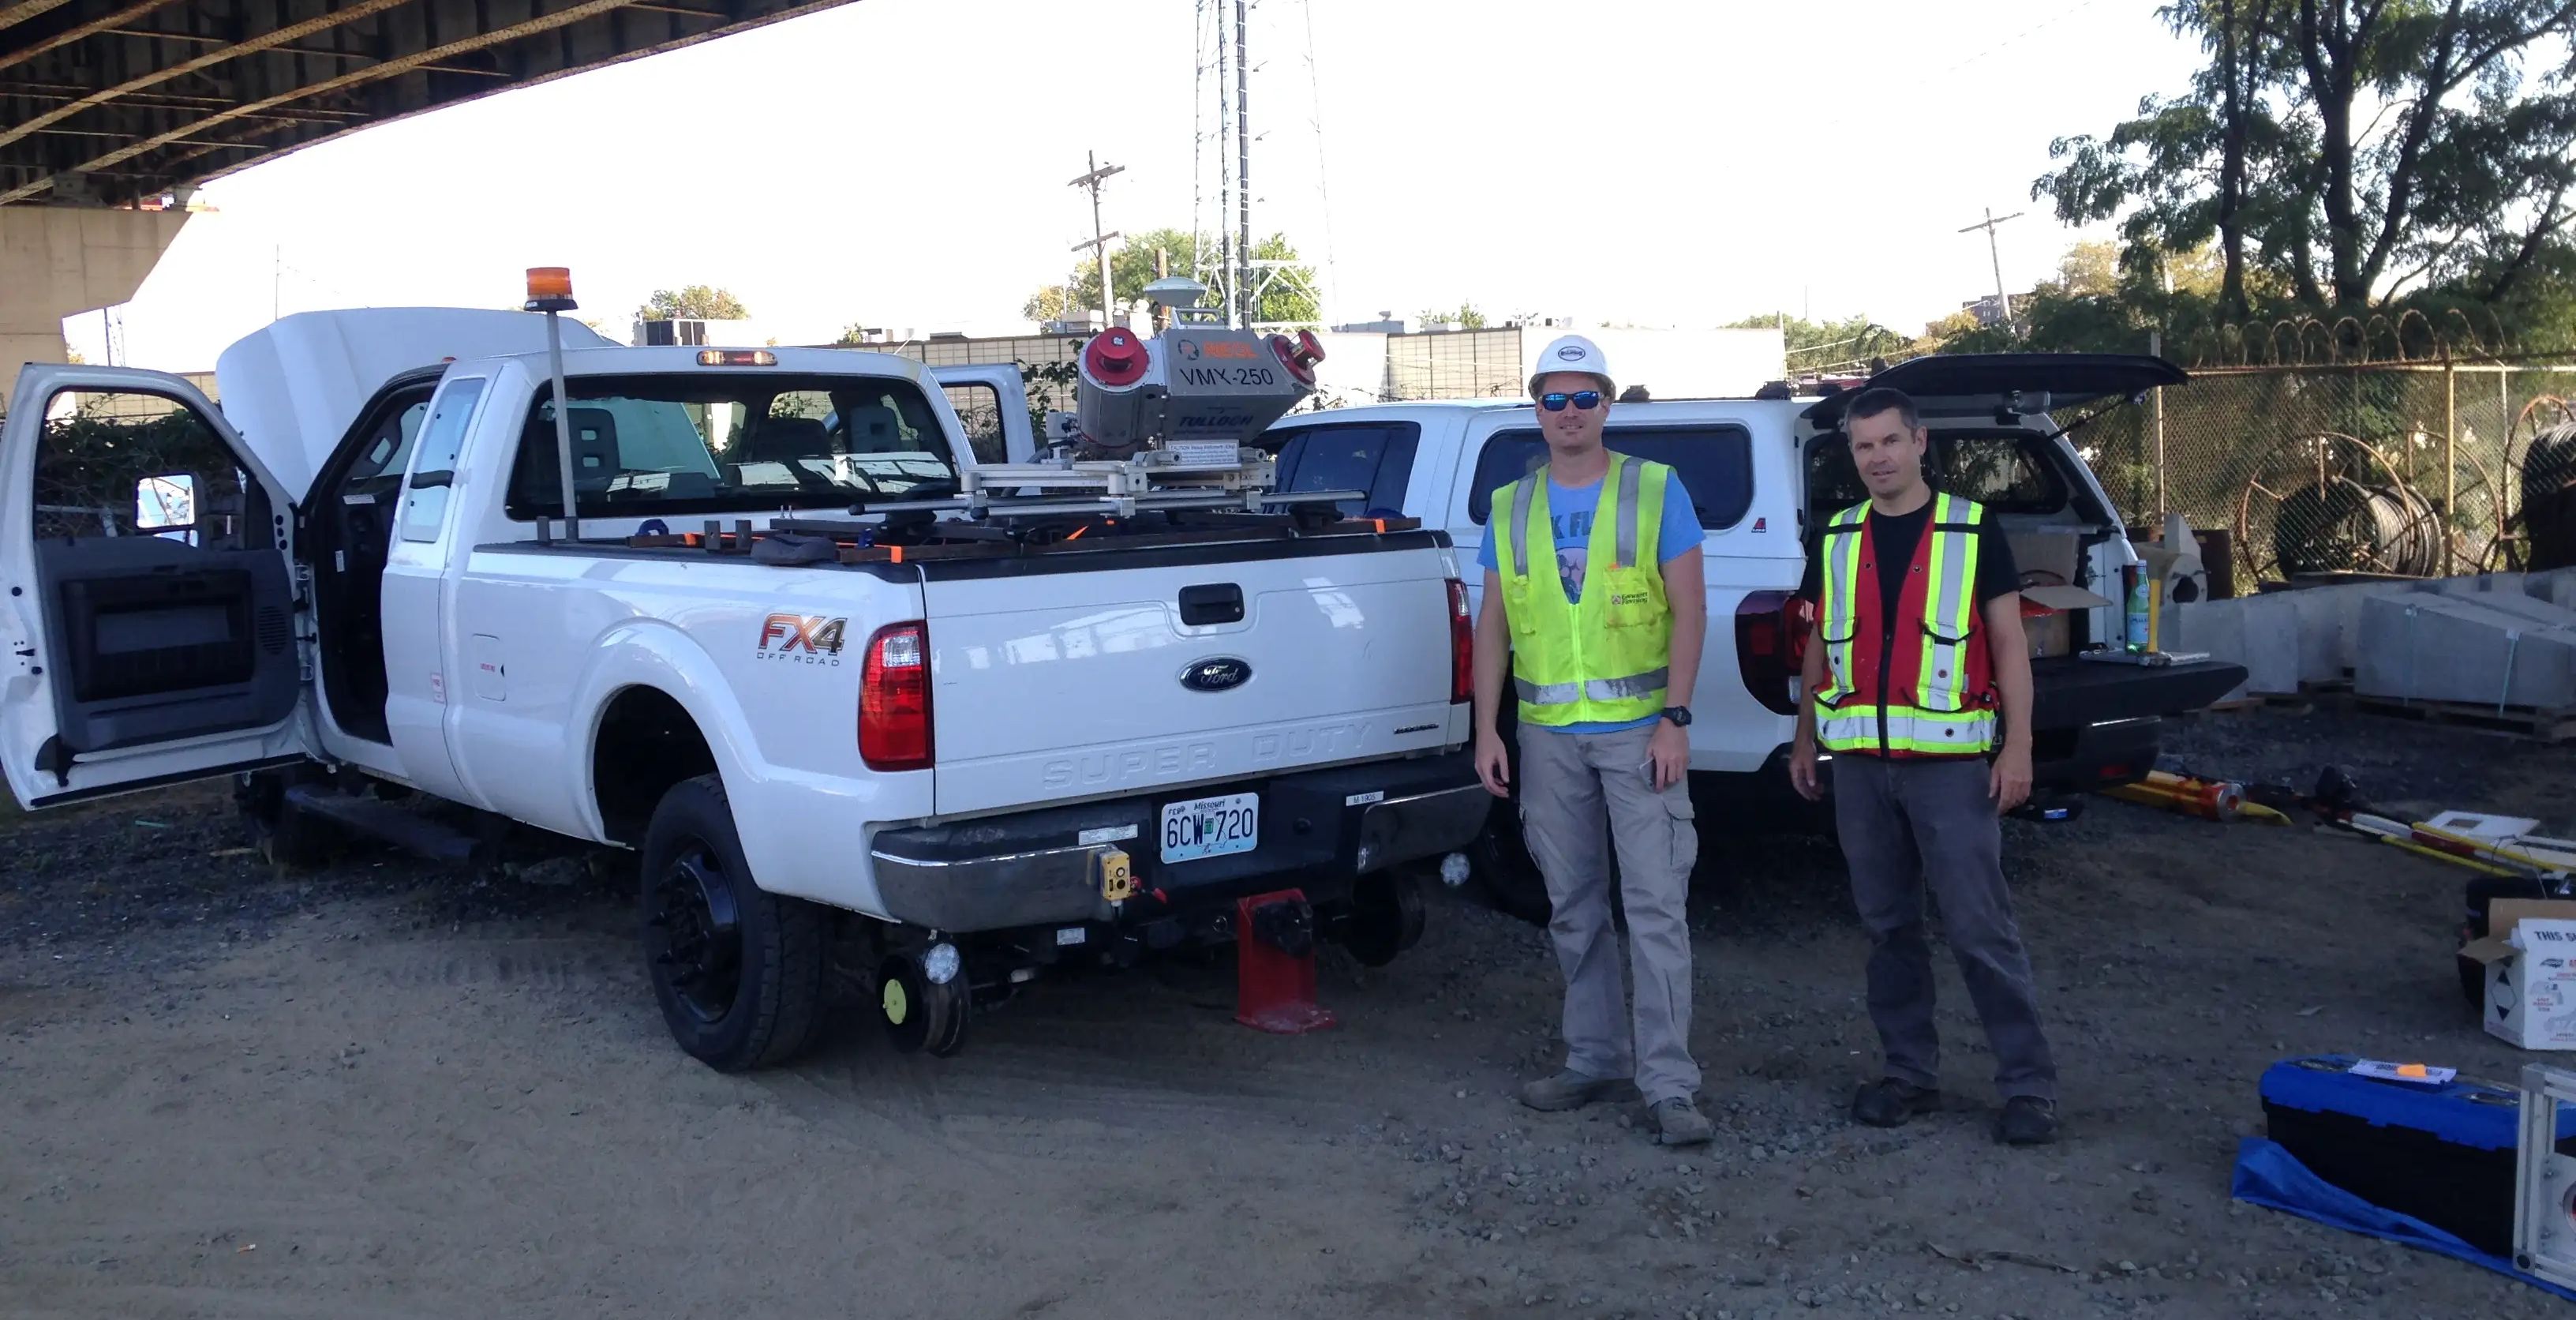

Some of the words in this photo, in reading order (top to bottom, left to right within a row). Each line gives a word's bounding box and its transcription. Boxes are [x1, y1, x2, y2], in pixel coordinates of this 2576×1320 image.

[1179, 368, 1274, 385] VMX-250
[758, 613, 848, 656] FX4
[757, 652, 786, 662] OFF
[794, 655, 840, 666] ROAD
[1200, 664, 1239, 684] Ford
[1043, 741, 1217, 789] SUPER
[1252, 722, 1372, 762] DUTY
[1194, 799, 1226, 811] Missouri
[1167, 813, 1204, 849] 6CW
[1215, 808, 1253, 842] 720
[2534, 931, 2563, 941] THIS
